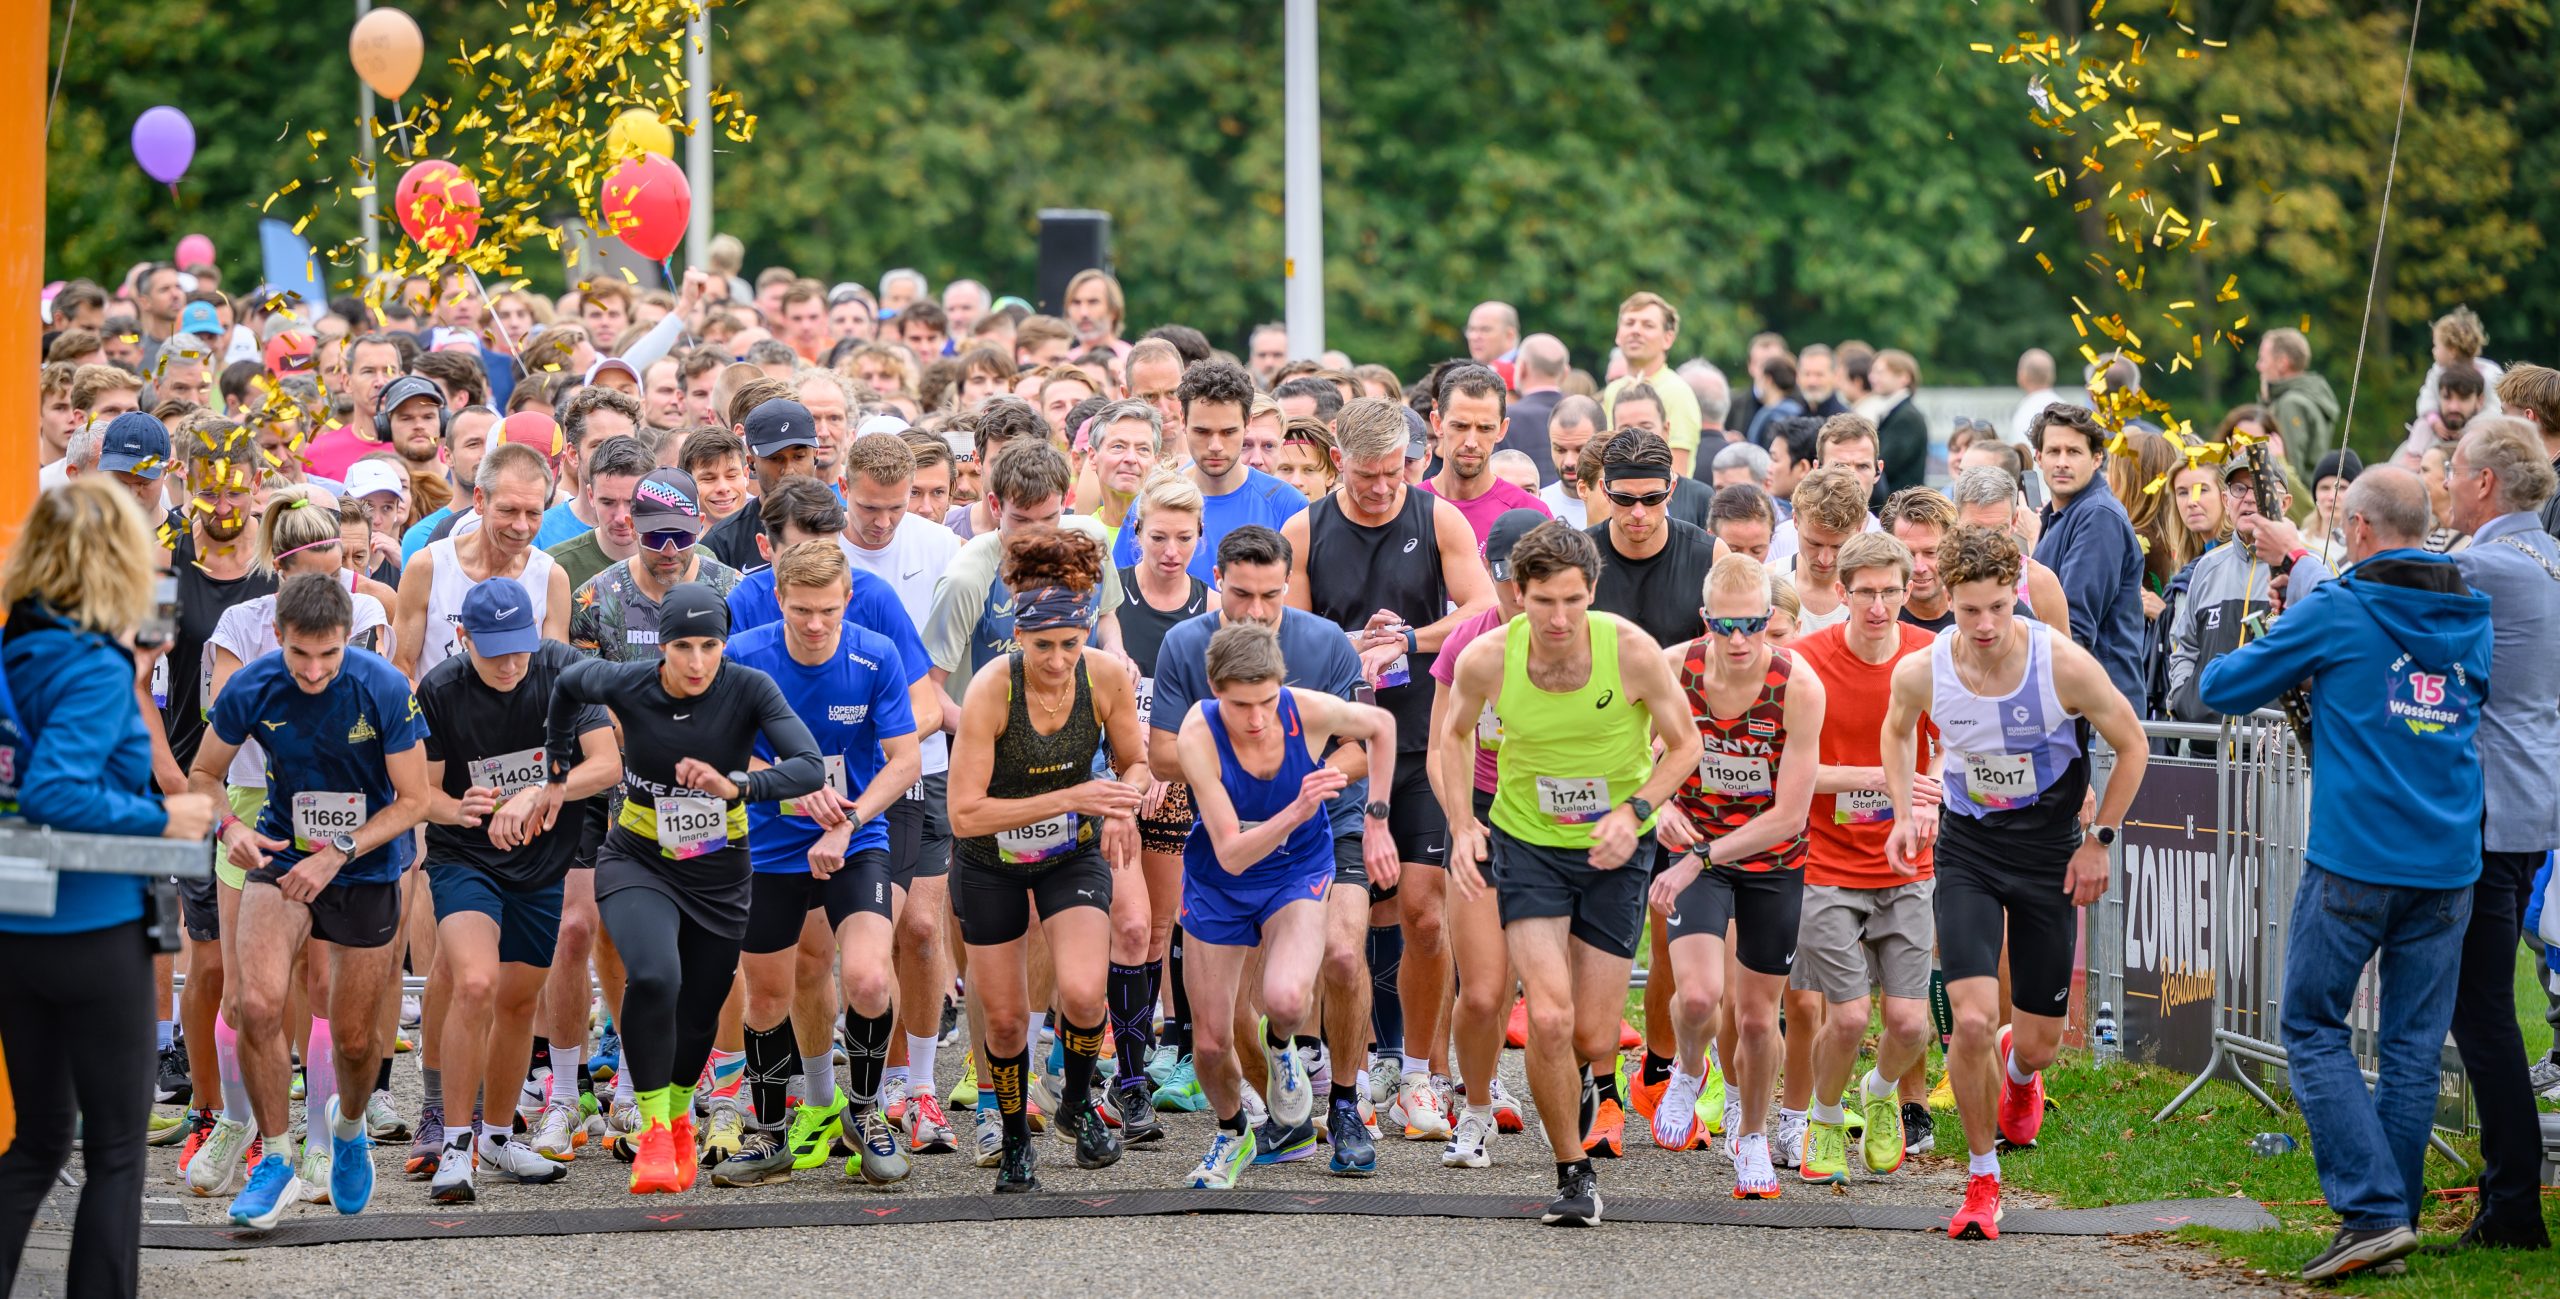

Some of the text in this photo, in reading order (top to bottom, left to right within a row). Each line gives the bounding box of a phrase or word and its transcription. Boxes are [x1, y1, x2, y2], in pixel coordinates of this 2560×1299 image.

[849, 653, 872, 667] CRAFT
[2409, 671, 2447, 706] 15
[2389, 700, 2459, 724] Wassenaar
[1703, 733, 1774, 756] ENYA
[489, 764, 544, 787] 11403
[625, 766, 667, 796] NIKE
[1706, 766, 1762, 782] 11906
[1973, 767, 2025, 785] 12017
[1551, 789, 1596, 804] 11741
[1721, 781, 1750, 791] Youri
[1552, 803, 1597, 813] Roeland
[1852, 799, 1888, 809] Stefan
[301, 809, 357, 827] 11662
[664, 812, 721, 833] 11303
[2186, 814, 2195, 840] DE
[678, 831, 709, 843] Imane
[1008, 822, 1060, 840] 11952
[875, 882, 883, 904] FUSION
[2160, 956, 2216, 1018] Restauran
[1935, 981, 1948, 1033] COMPRESSPORT
[992, 1063, 1022, 1115] SPARTAN
